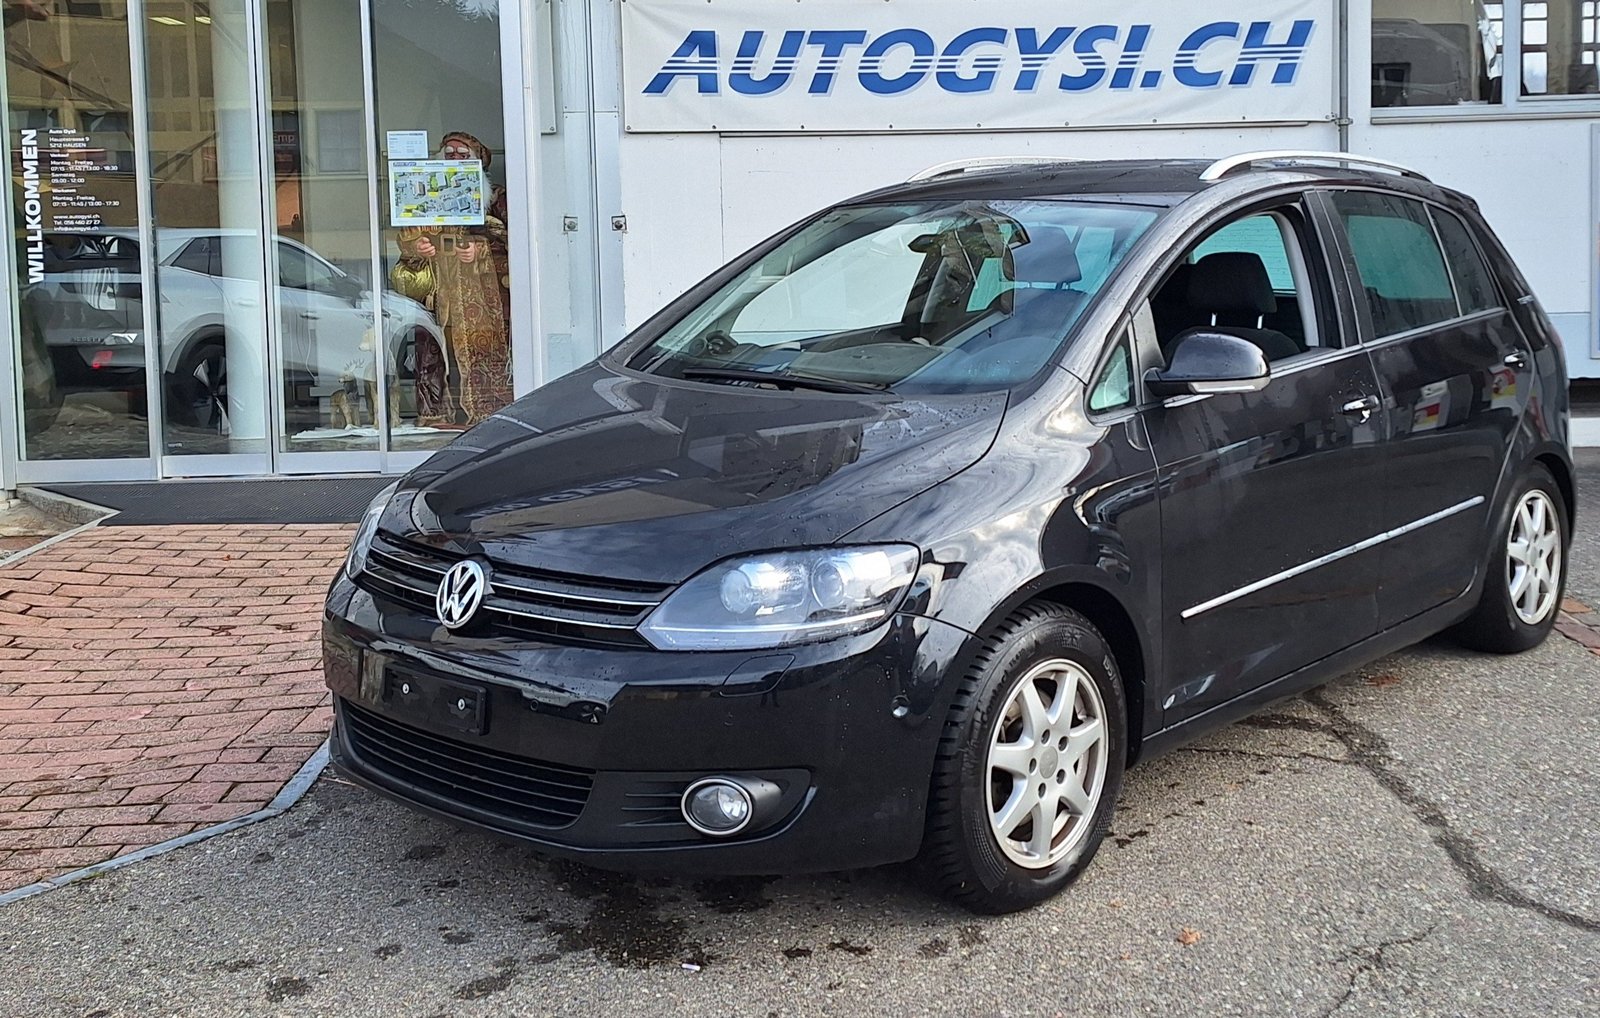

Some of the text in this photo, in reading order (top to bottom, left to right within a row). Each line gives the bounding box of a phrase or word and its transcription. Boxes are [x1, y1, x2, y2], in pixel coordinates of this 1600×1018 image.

[641, 20, 1316, 96] AUTOGYSI.CH
[21, 129, 44, 284] WILLKOMMEN
[436, 560, 485, 629] VW
